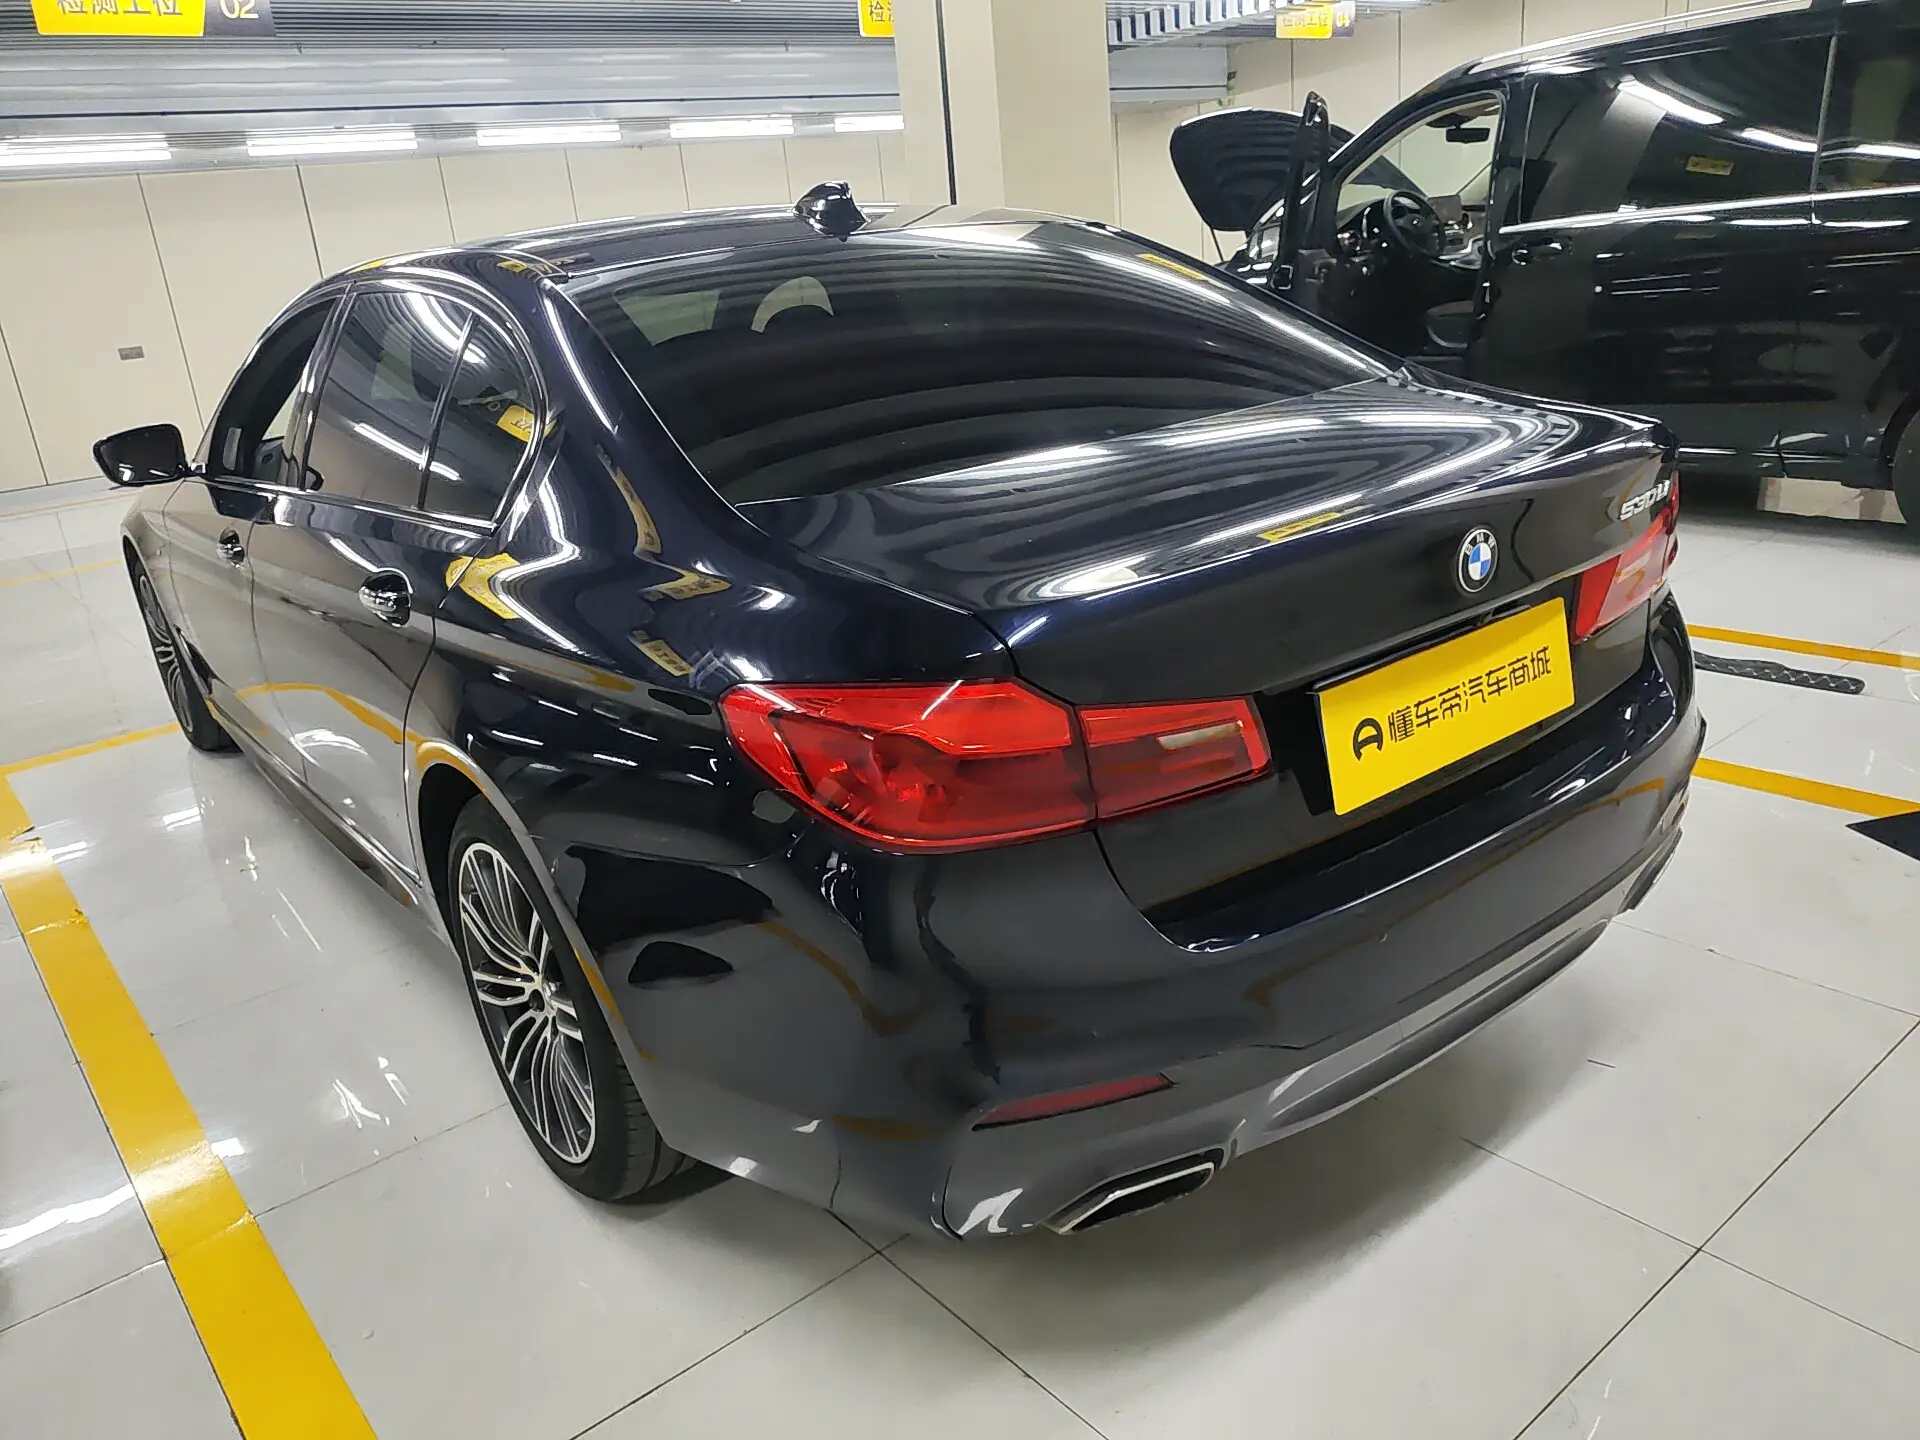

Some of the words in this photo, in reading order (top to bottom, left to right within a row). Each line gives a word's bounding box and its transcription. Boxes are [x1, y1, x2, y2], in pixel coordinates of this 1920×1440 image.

[219, 0, 260, 19] 02
[868, 0, 894, 23] 检
[1464, 532, 1496, 556] BMW
[1387, 645, 1552, 743] 懂车帝汽车商城
